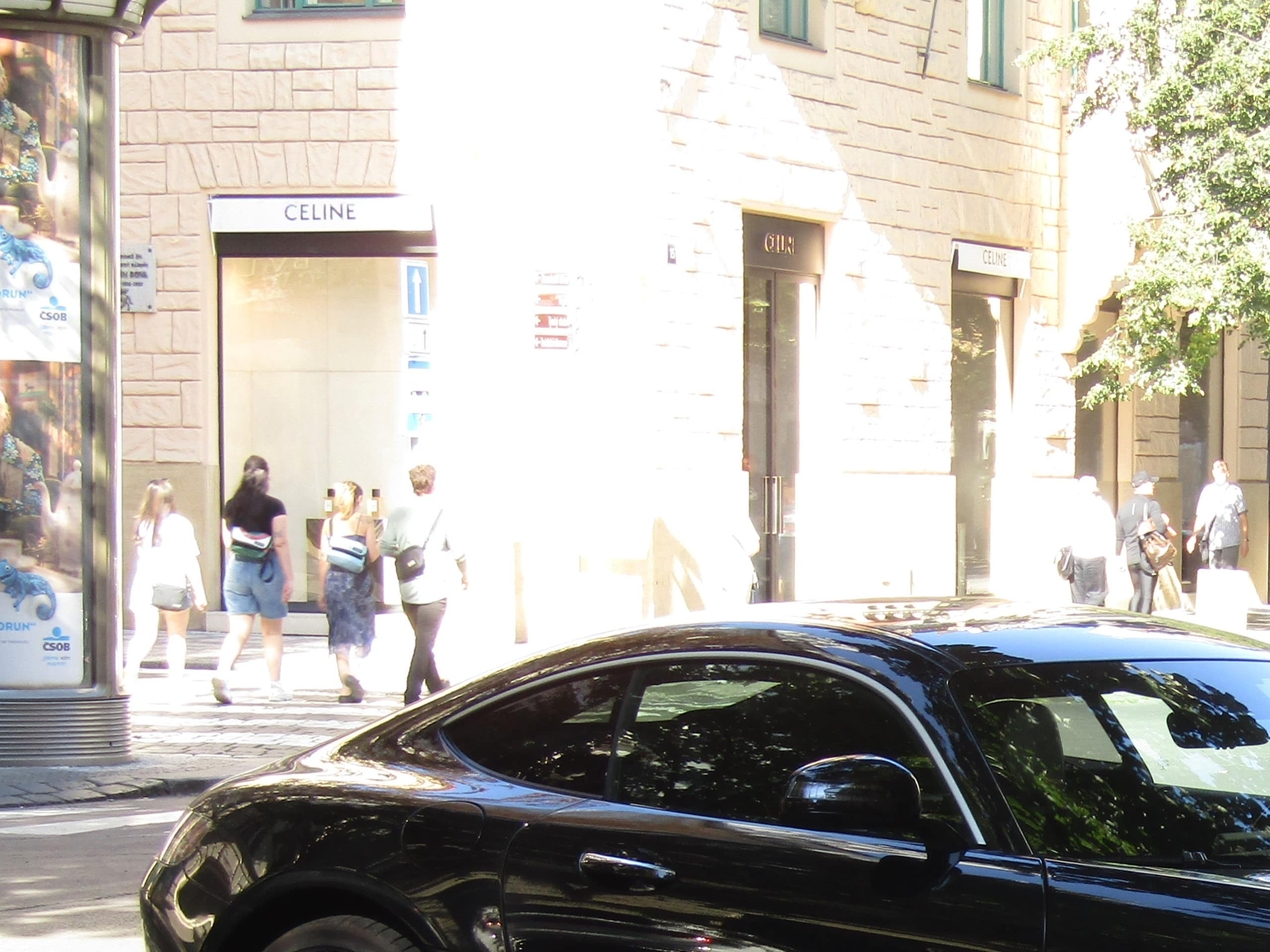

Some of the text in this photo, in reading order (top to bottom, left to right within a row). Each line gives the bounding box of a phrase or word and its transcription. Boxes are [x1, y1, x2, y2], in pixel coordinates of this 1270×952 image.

[283, 203, 356, 221] CELINE
[982, 249, 1008, 267] CELINE
[43, 642, 71, 652] ČSOB
